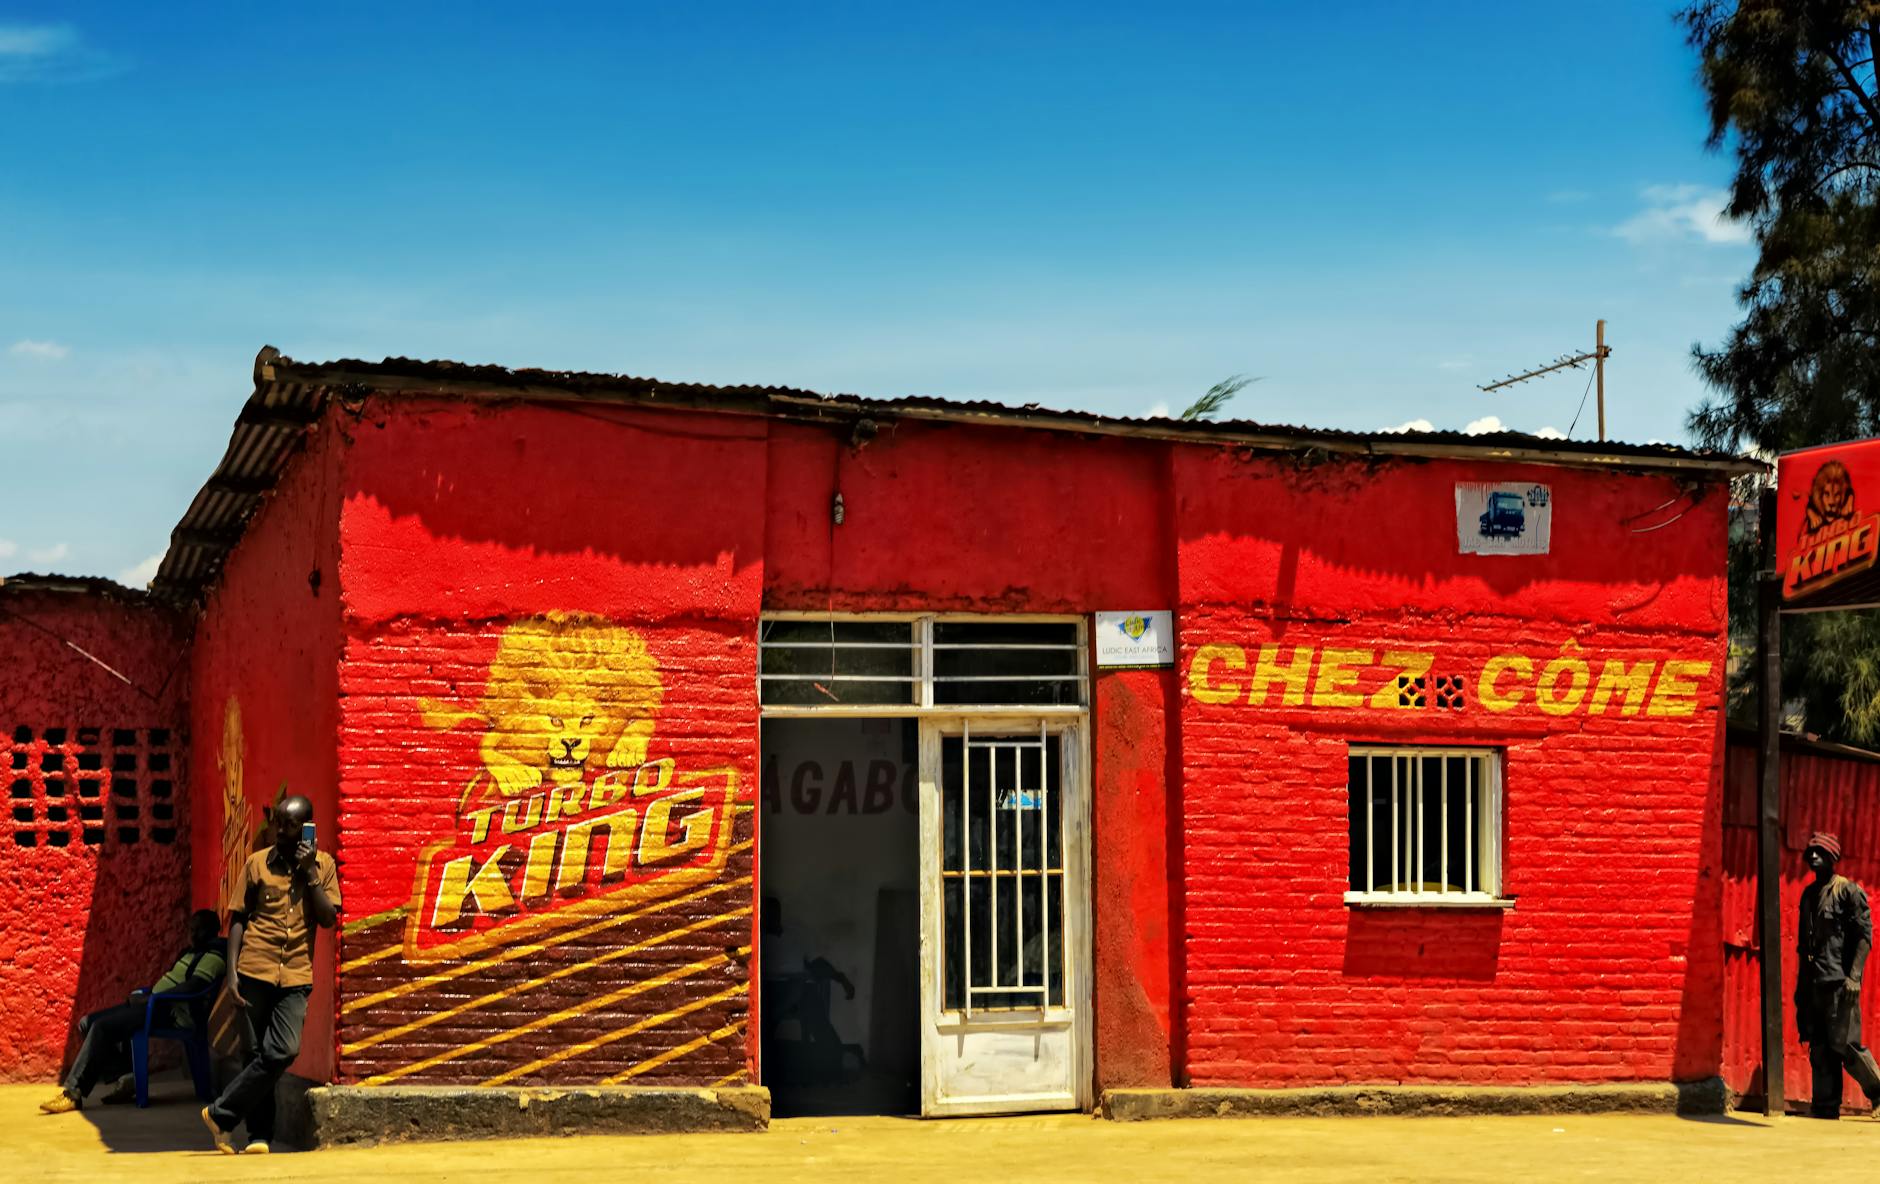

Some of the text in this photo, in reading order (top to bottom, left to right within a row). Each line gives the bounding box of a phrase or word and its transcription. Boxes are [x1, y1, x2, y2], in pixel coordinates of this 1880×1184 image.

[1800, 511, 1862, 550] TURBO
[1102, 645, 1168, 655] LUDIC EAST AFRICA
[1188, 638, 1714, 717] CHEZ CÔME
[466, 757, 676, 845] TURBO
